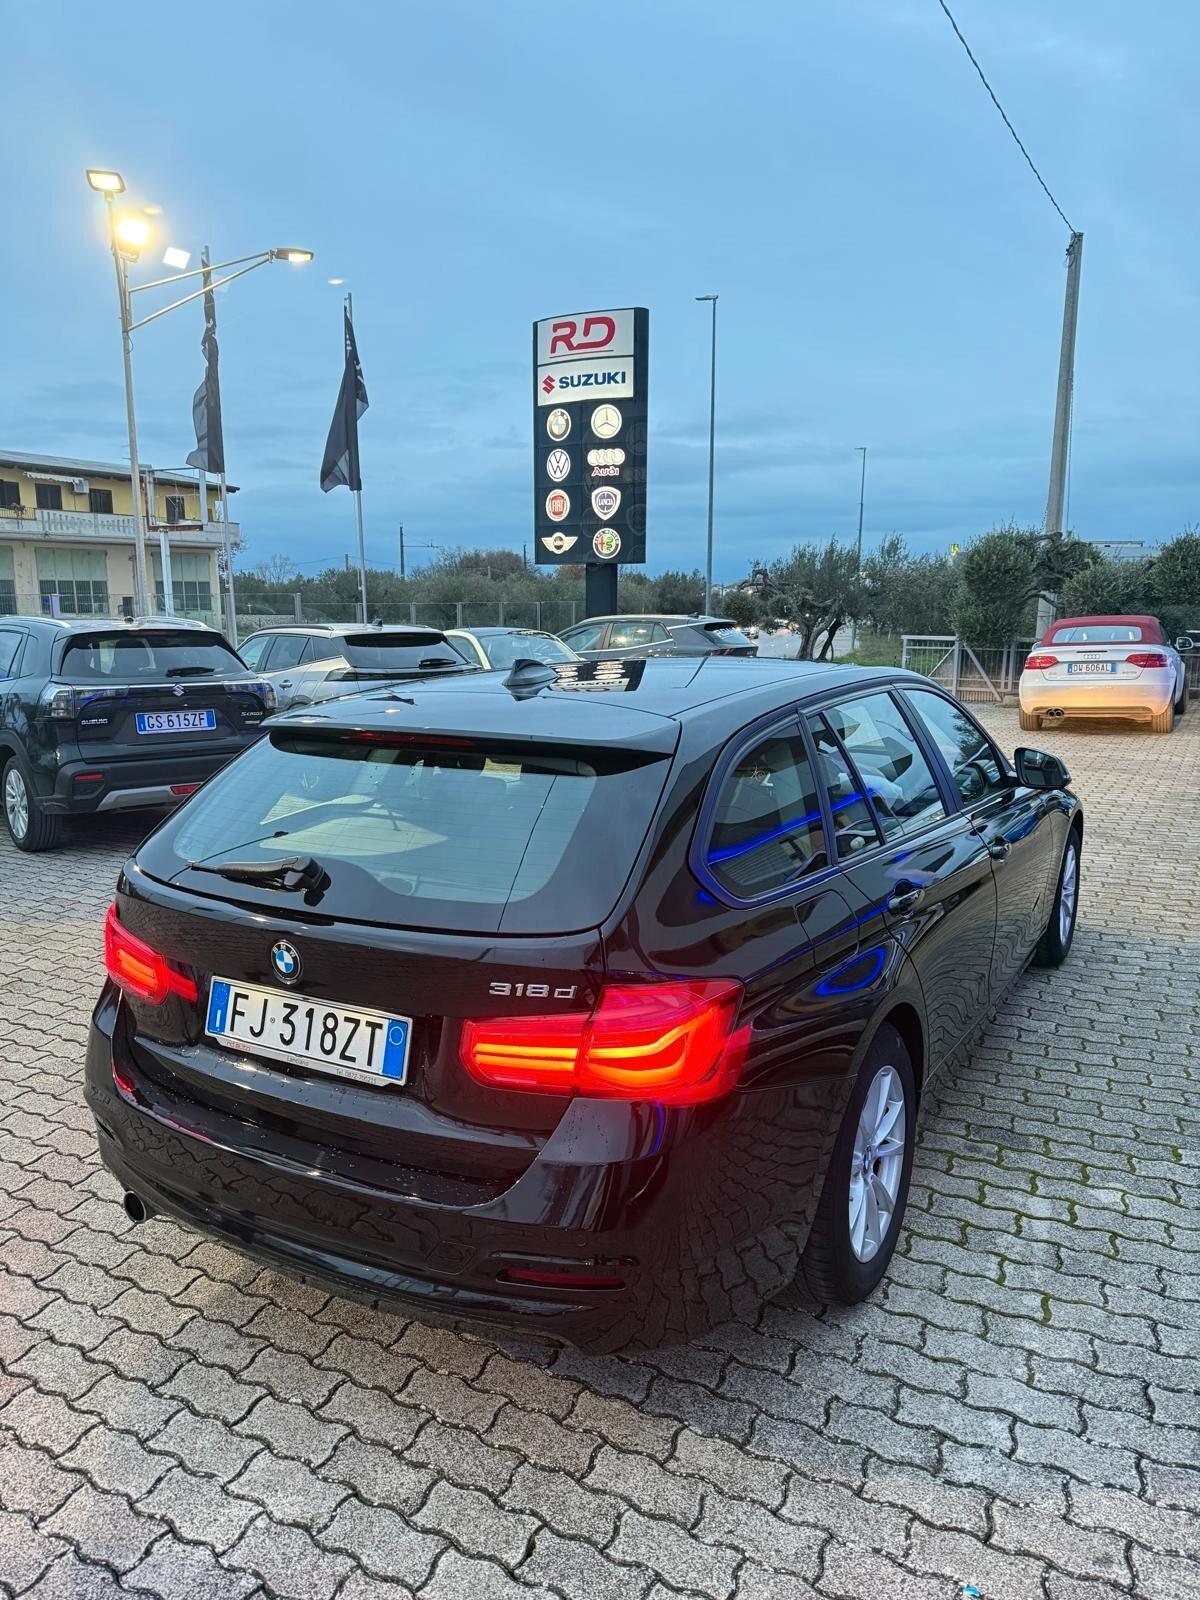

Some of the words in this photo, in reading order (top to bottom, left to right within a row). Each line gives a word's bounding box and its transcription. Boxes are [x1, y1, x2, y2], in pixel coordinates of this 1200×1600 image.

[550, 316, 616, 354] RD
[558, 371, 626, 389] SUZUKI
[1073, 663, 1084, 672] DW
[1085, 663, 1110, 672] 606AL
[147, 715, 163, 729] GS
[167, 712, 205, 728] 615ZF
[272, 943, 296, 958] BMW
[230, 991, 268, 1038] FJ
[279, 1002, 383, 1067] 318ZT
